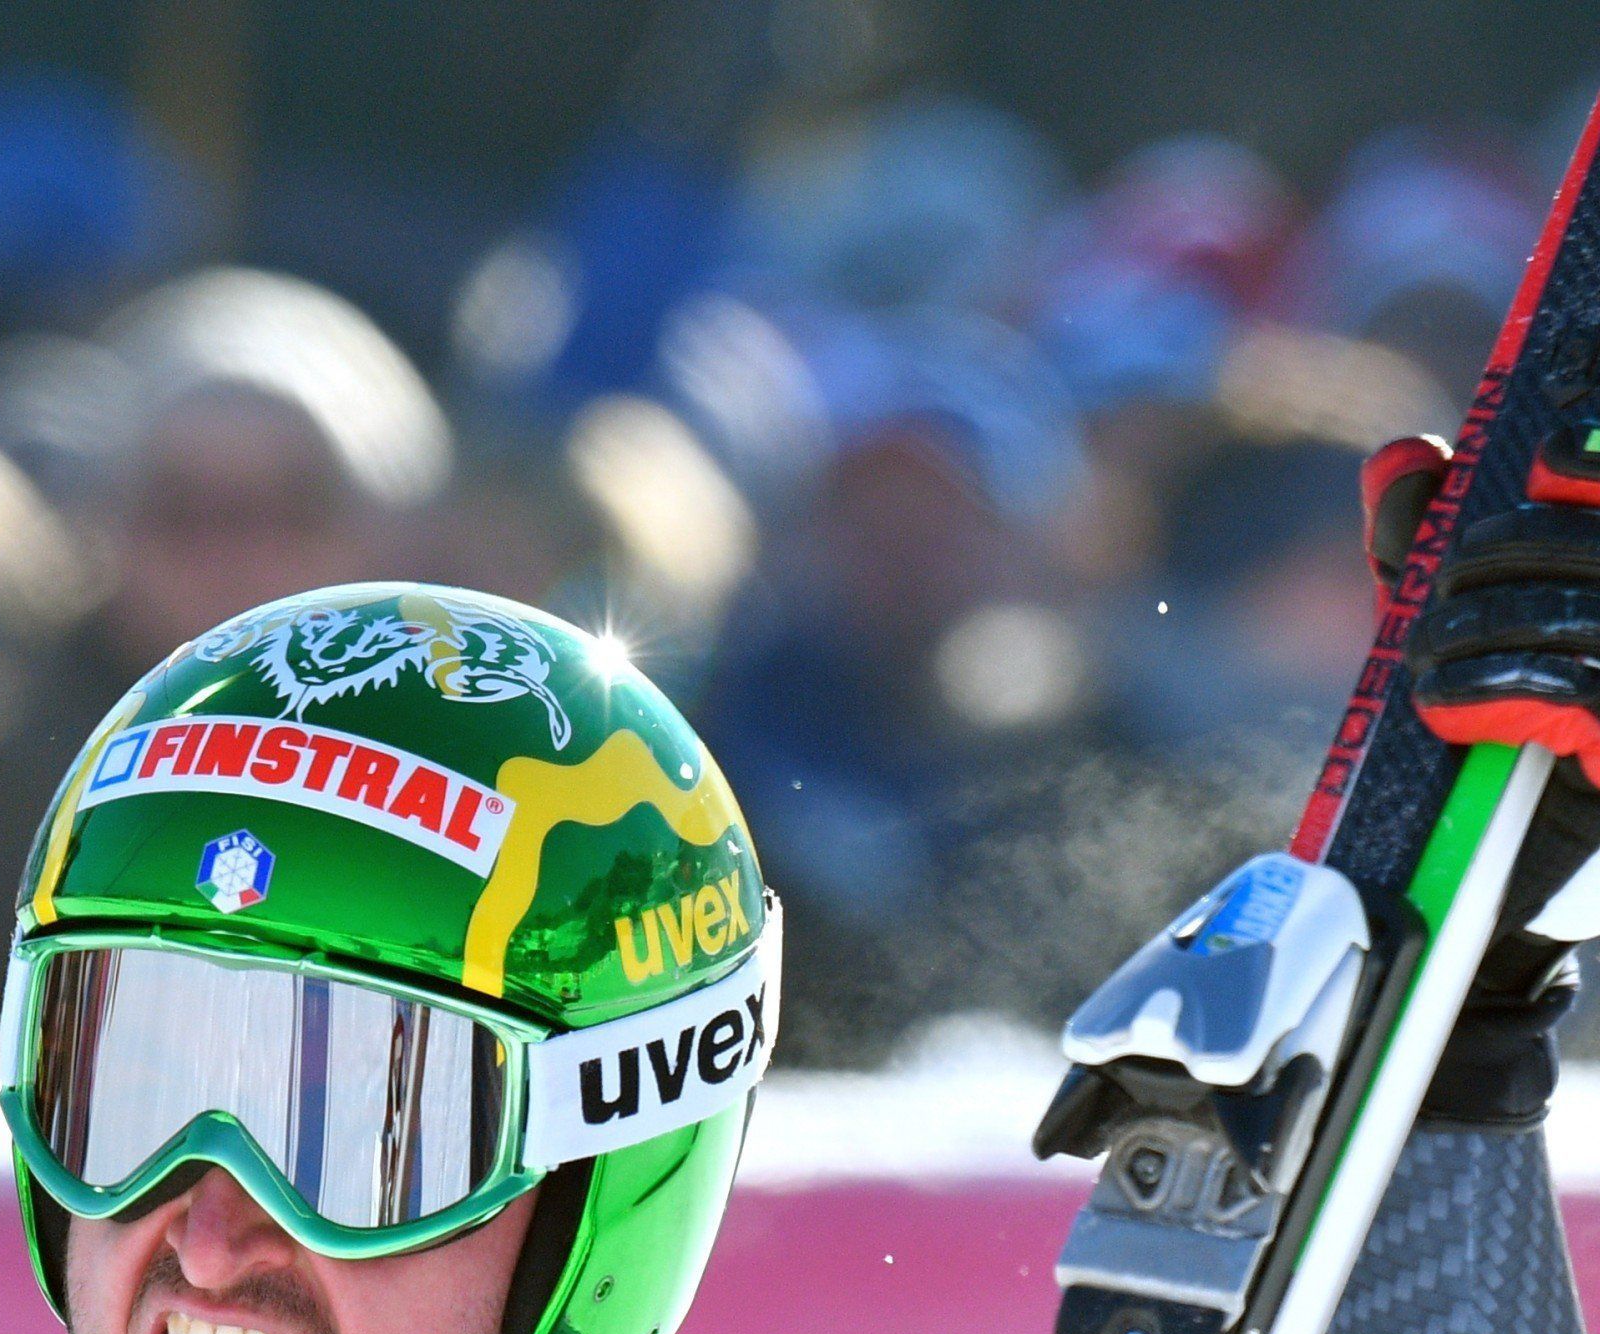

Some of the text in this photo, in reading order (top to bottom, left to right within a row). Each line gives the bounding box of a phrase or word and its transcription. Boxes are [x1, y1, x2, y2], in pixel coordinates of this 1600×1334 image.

[217, 834, 263, 859] FISI
[614, 869, 750, 985] uvex
[1208, 860, 1306, 947] ARKER
[579, 982, 766, 1126] uvex
